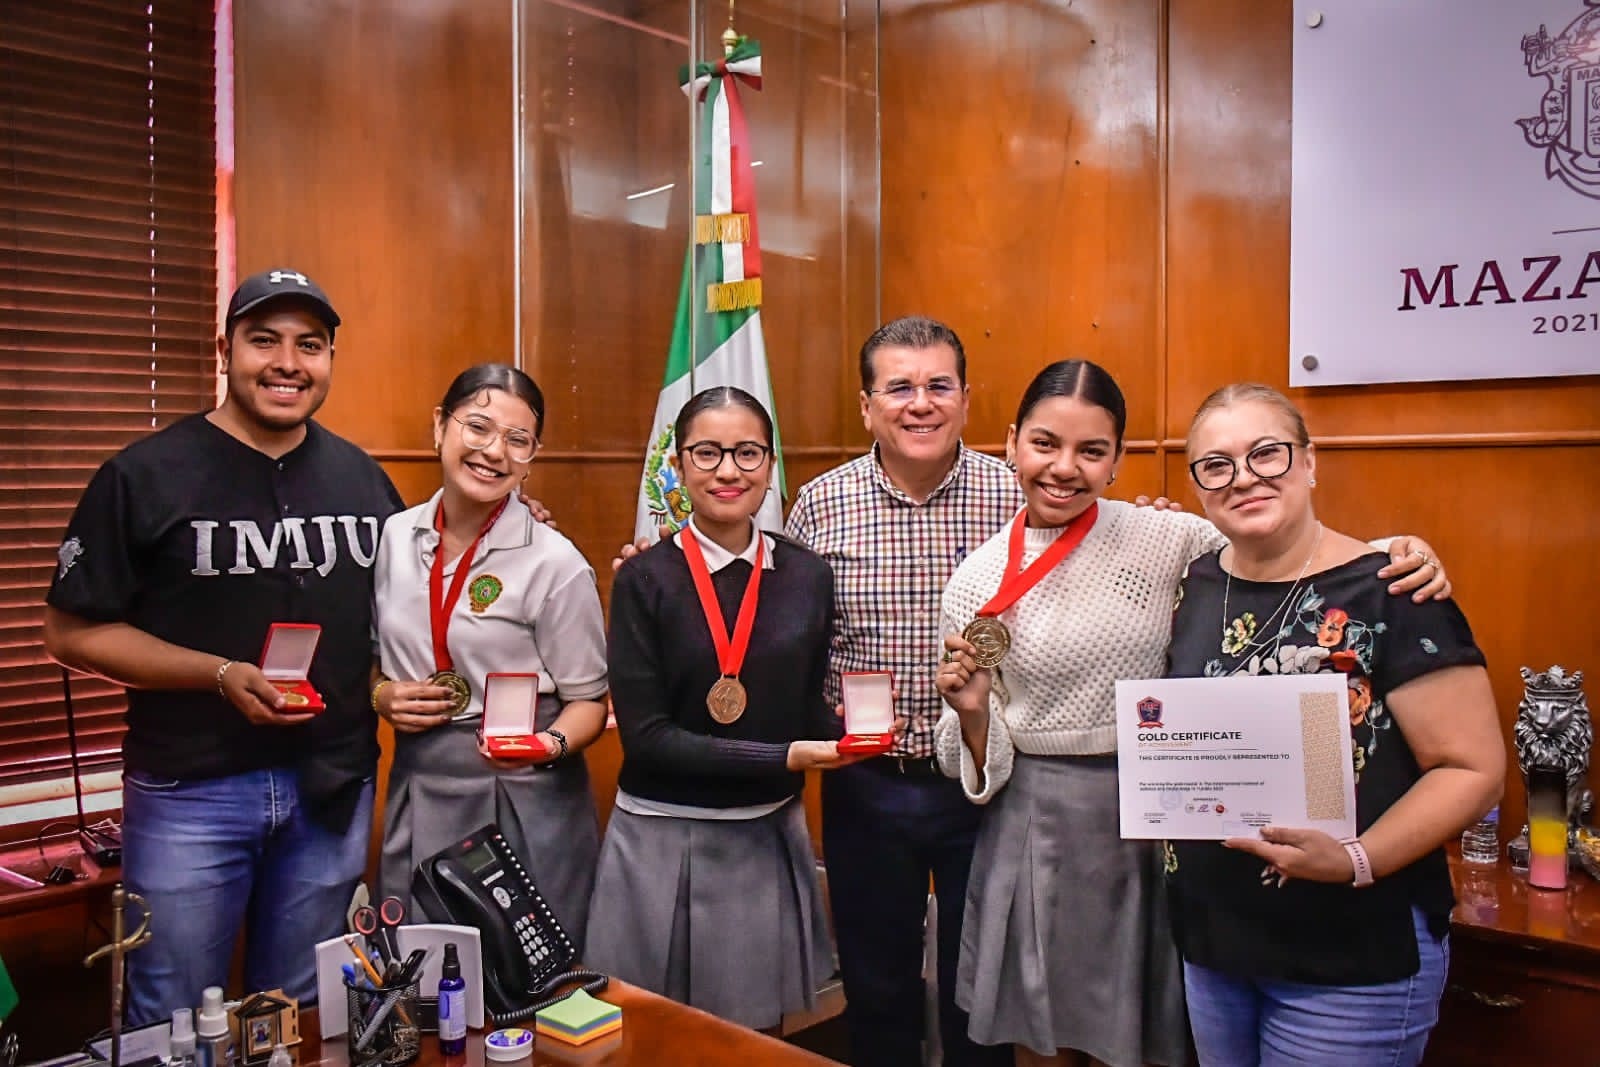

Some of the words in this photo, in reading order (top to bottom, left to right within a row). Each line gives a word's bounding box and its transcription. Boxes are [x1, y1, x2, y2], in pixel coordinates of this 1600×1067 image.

[1397, 251, 1600, 311] MAZA
[190, 516, 378, 577] IMJU
[1138, 732, 1168, 741] GOLD
[1171, 731, 1242, 741] CERTIFICATE
